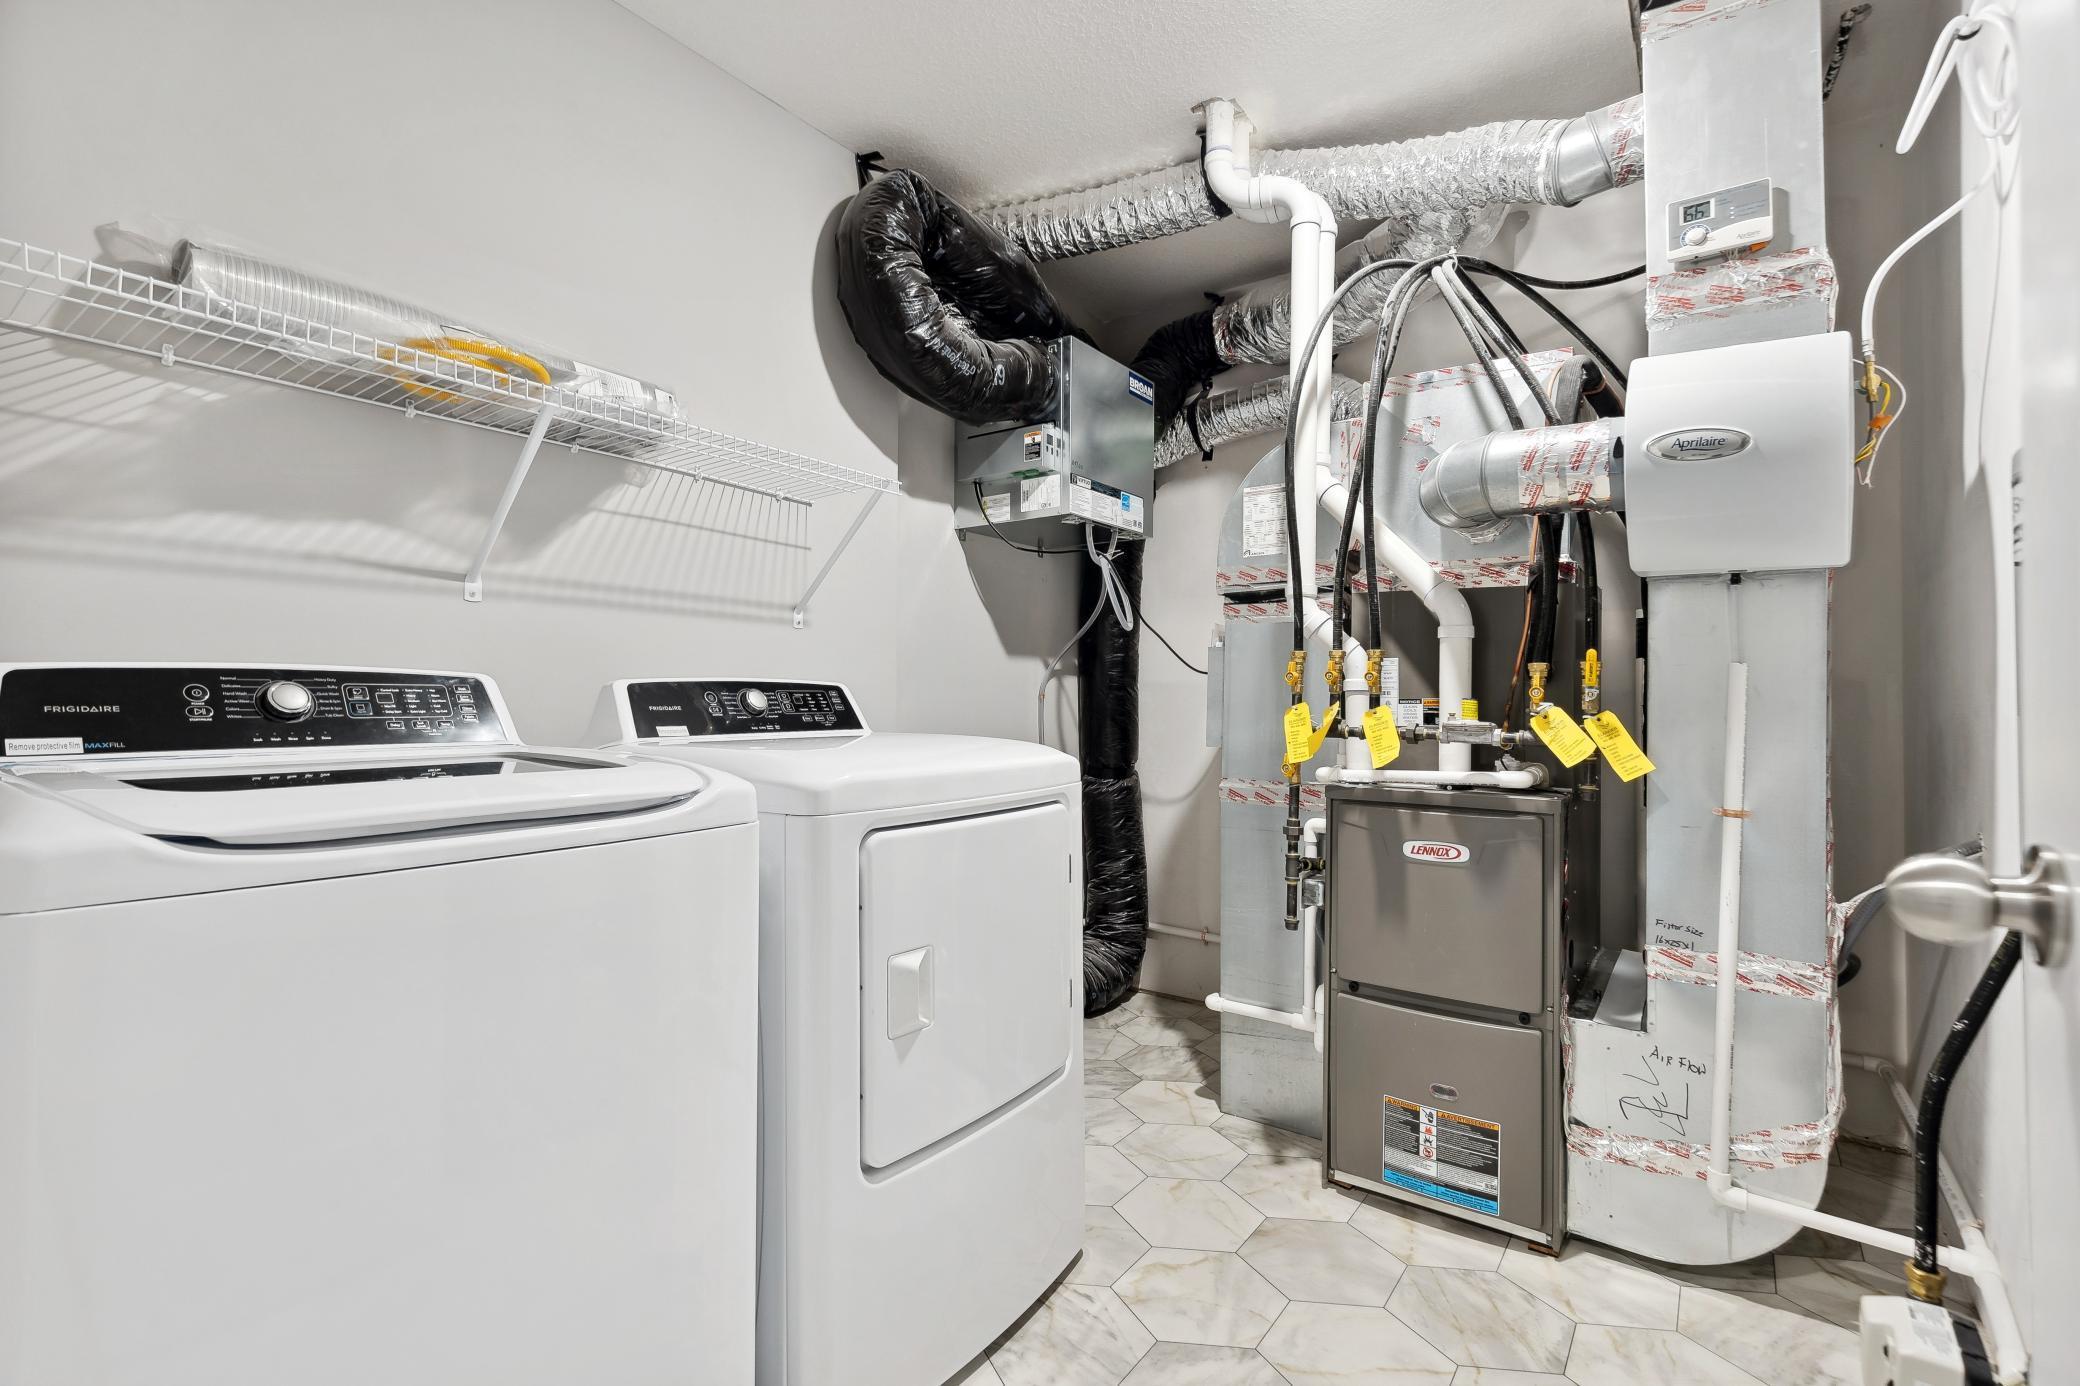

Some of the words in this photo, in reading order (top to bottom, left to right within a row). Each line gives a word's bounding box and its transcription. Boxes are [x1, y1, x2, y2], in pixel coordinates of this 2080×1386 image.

[1129, 376, 1153, 398] BROAN
[1671, 436, 1727, 452] Aprilaire
[44, 705, 121, 713] FRIGIDAIRE
[8, 742, 36, 751] Remove
[36, 741, 68, 752] protective
[1410, 844, 1452, 858] LENNOX
